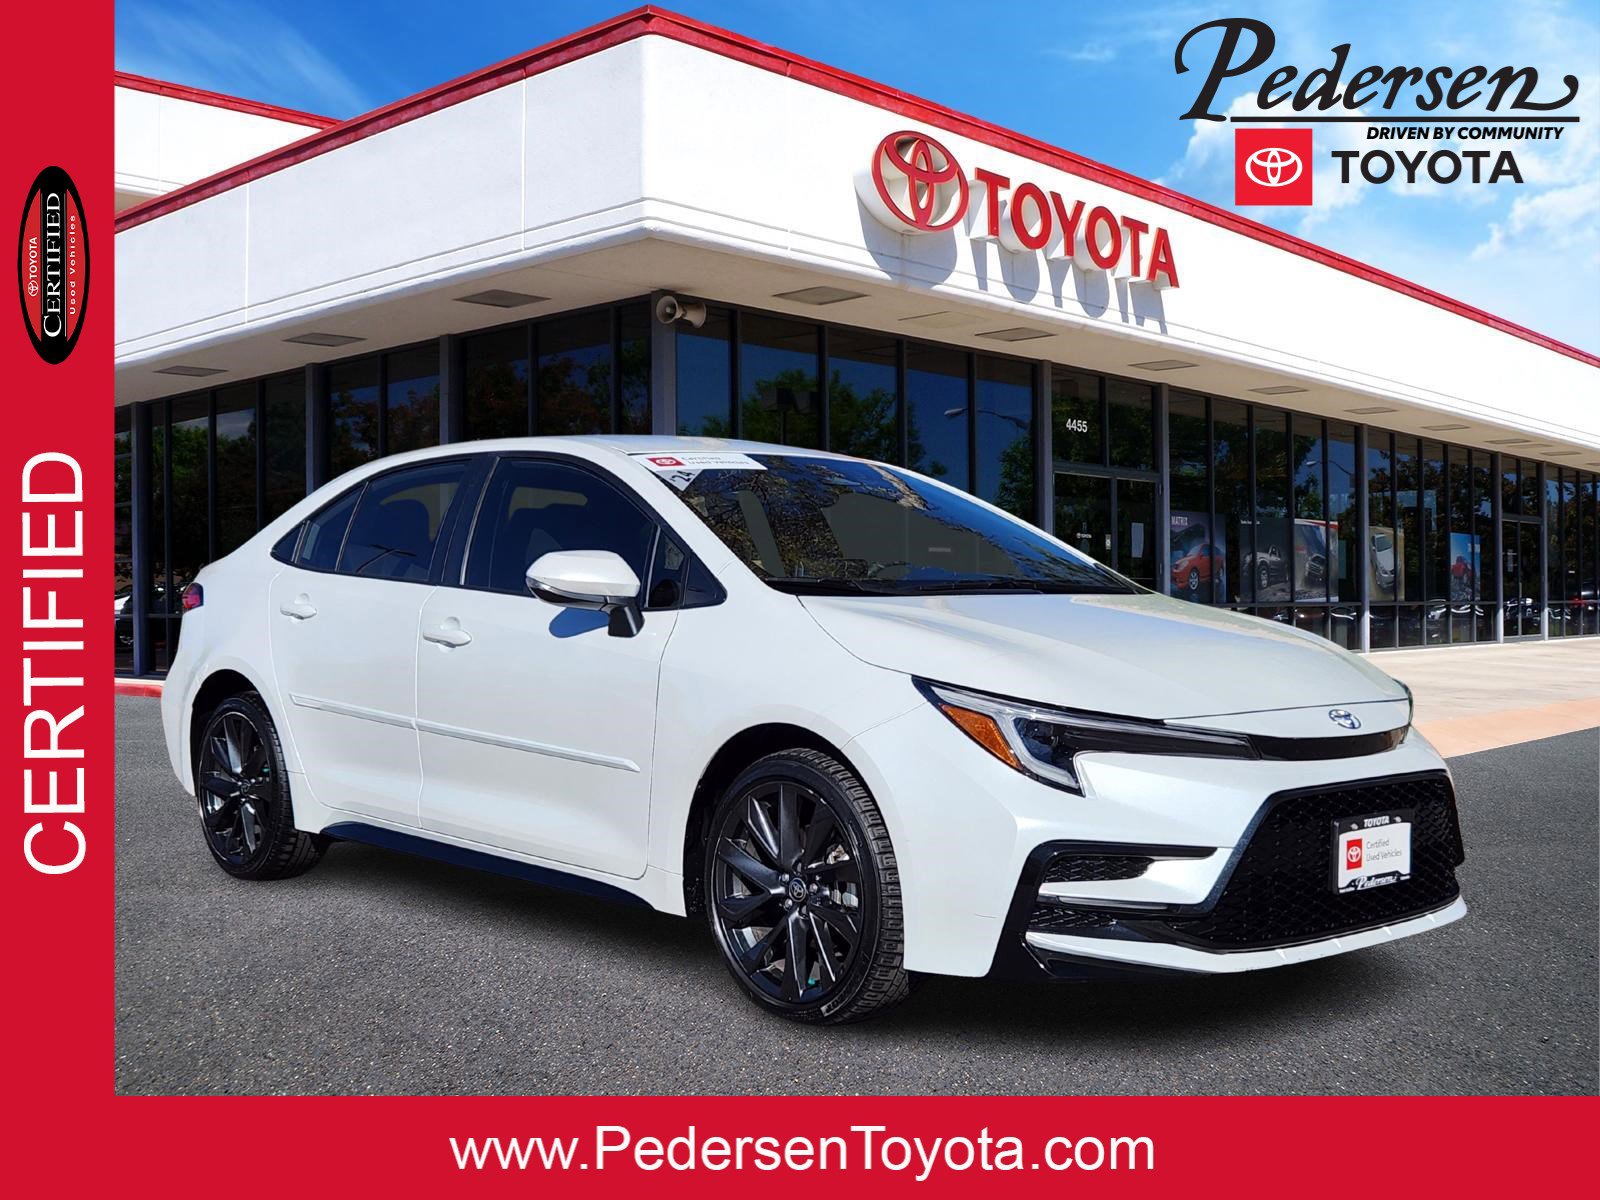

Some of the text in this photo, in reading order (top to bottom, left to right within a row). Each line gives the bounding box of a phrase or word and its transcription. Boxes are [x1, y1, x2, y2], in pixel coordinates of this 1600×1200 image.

[974, 167, 1180, 289] TOYOTA
[1065, 418, 1088, 433] 4455
[1363, 815, 1390, 828] TOYOTA
